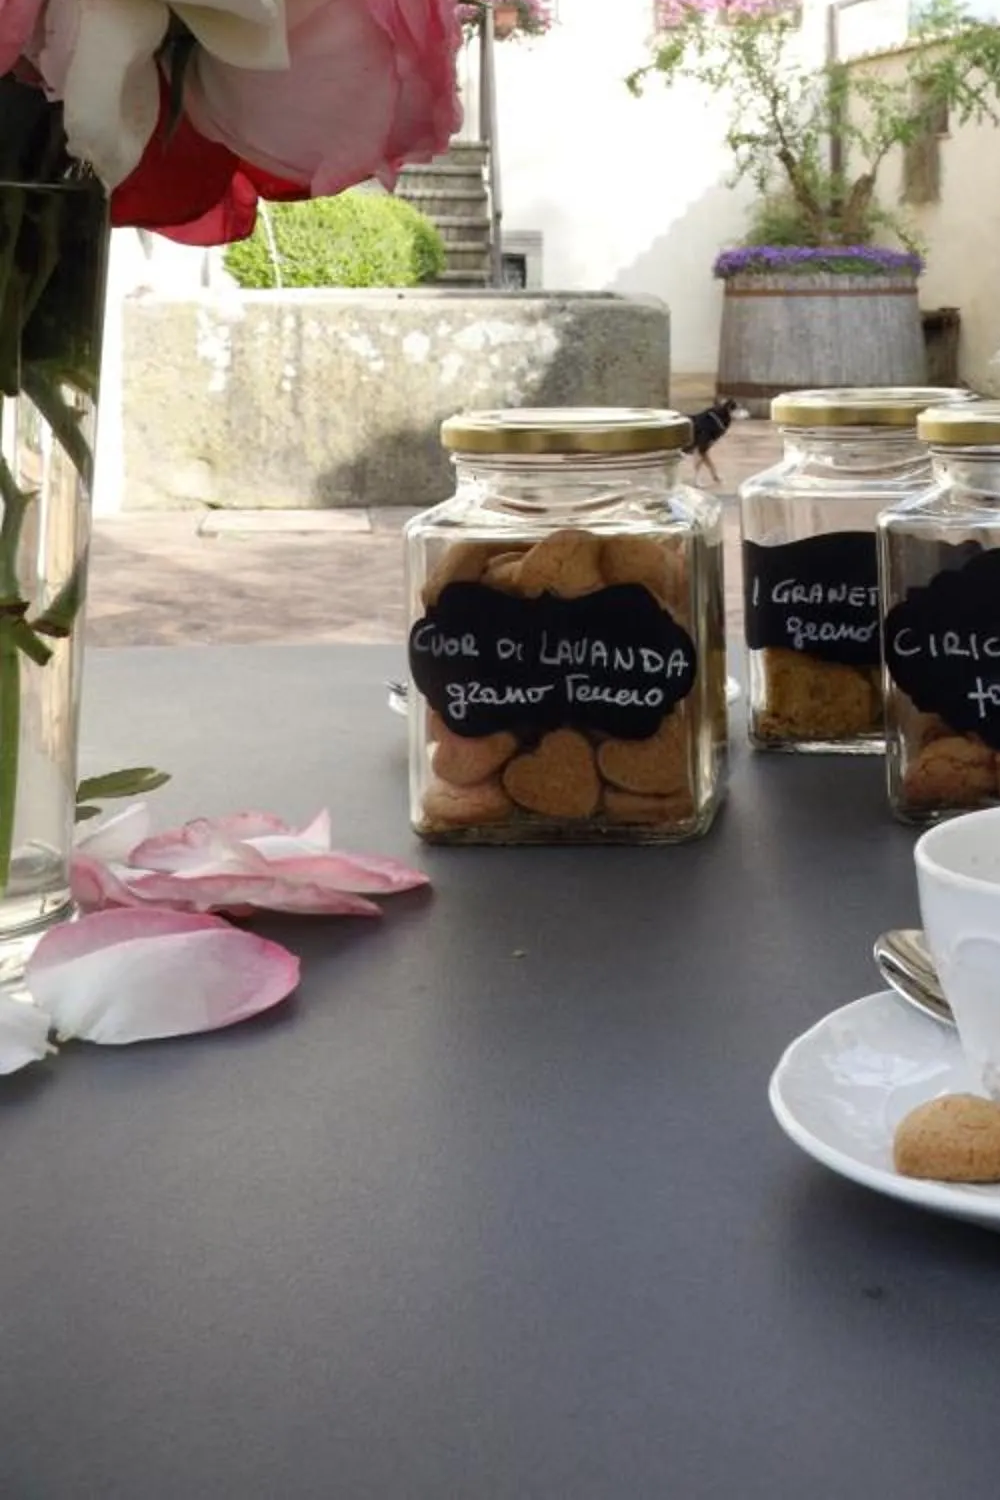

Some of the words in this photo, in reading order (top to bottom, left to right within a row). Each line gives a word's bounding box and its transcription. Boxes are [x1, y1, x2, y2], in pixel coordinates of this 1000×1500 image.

[412, 622, 480, 657] CUOR
[540, 630, 690, 678] LAVANDA
[445, 682, 554, 720] grano
